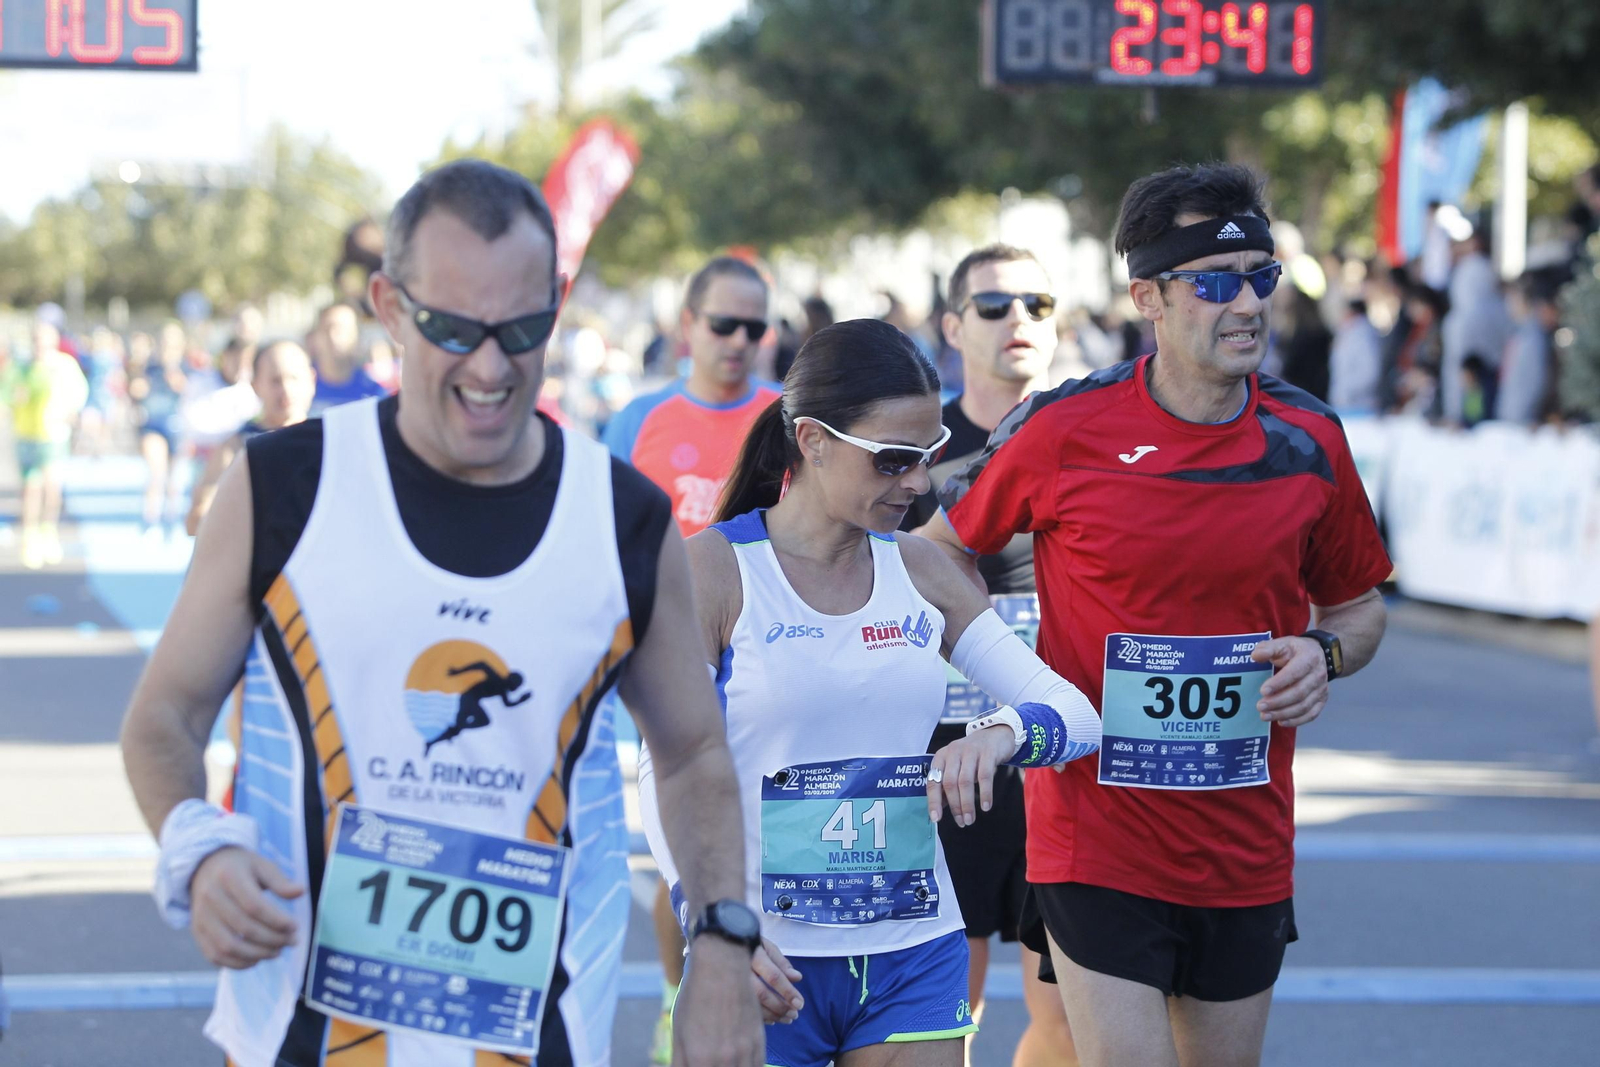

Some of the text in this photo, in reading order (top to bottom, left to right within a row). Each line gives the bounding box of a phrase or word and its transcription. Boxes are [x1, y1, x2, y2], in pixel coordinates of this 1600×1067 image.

[1111, 0, 1314, 75] 23:41
[1217, 232, 1246, 240] adidas
[437, 599, 491, 625] vive
[874, 619, 899, 627] CLUB
[785, 624, 825, 639] asics
[861, 626, 903, 643] Run
[866, 640, 908, 651] atletismo
[1232, 642, 1259, 652] MED
[1146, 650, 1185, 659] MARATÓN
[1213, 654, 1256, 665] MARAT
[1146, 658, 1180, 666] ALMERÍA
[1143, 676, 1242, 720] 305
[1161, 721, 1221, 732] VICENTE
[1112, 742, 1134, 752] NEXA
[1138, 744, 1156, 752] CDX
[805, 767, 831, 775] MEDIO
[895, 764, 922, 775] MEDI
[432, 763, 525, 791] RINCÓN
[804, 772, 846, 782] MARATÓN
[804, 781, 841, 790] ALMERÍA
[821, 799, 887, 850] 41
[828, 851, 885, 864] MARISA
[774, 880, 796, 890] NEXA
[801, 878, 820, 888] CDX
[359, 870, 533, 953] 1709
